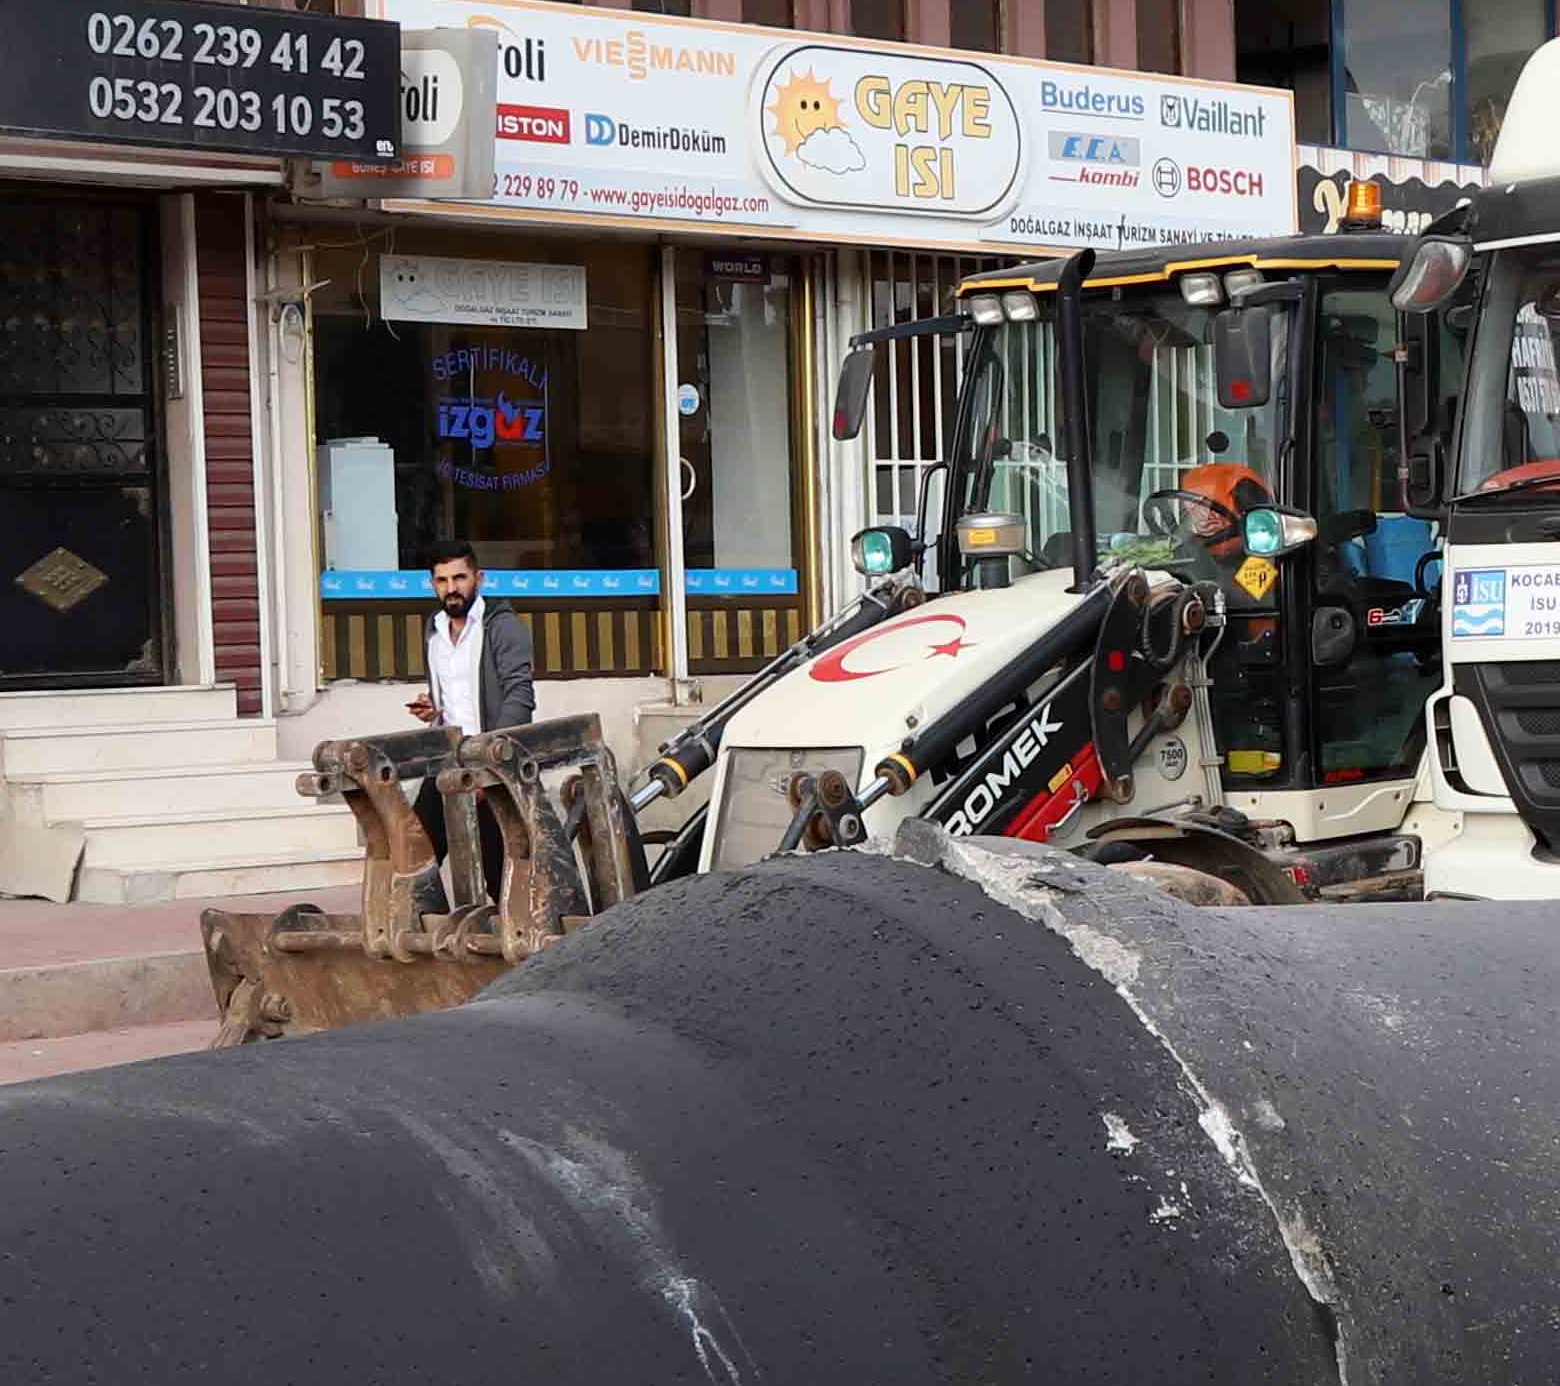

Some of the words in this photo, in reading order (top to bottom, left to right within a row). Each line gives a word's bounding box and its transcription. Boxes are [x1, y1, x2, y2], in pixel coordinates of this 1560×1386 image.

[87, 12, 184, 61] 0262
[192, 23, 262, 68] 239
[269, 32, 309, 74] 41
[321, 38, 366, 80] 42
[89, 76, 183, 125] 0532
[193, 86, 262, 131] 203
[271, 93, 313, 136] 10
[321, 98, 366, 140] 53
[852, 74, 993, 143] GAYE
[1040, 79, 1145, 115] Buderus
[497, 114, 565, 138] ISTON
[1181, 98, 1267, 139] Vaillant
[618, 122, 727, 155] DemirDöküm
[893, 142, 955, 201] ISI
[1079, 166, 1141, 189] kombi
[1187, 166, 1264, 198] BOSCH
[503, 174, 533, 199] 229
[536, 177, 556, 201] 89
[559, 179, 580, 202] 79
[1010, 215, 1071, 239] DOĞALGAZ
[1074, 217, 1113, 243] İNŞAAT
[1117, 220, 1157, 244] TURİZM
[1159, 227, 1198, 246] SANAYİ
[712, 260, 761, 274] WORLD
[1530, 592, 1557, 611] İSU
[943, 702, 1064, 837] ROMEK
[1159, 749, 1183, 761] 7500
